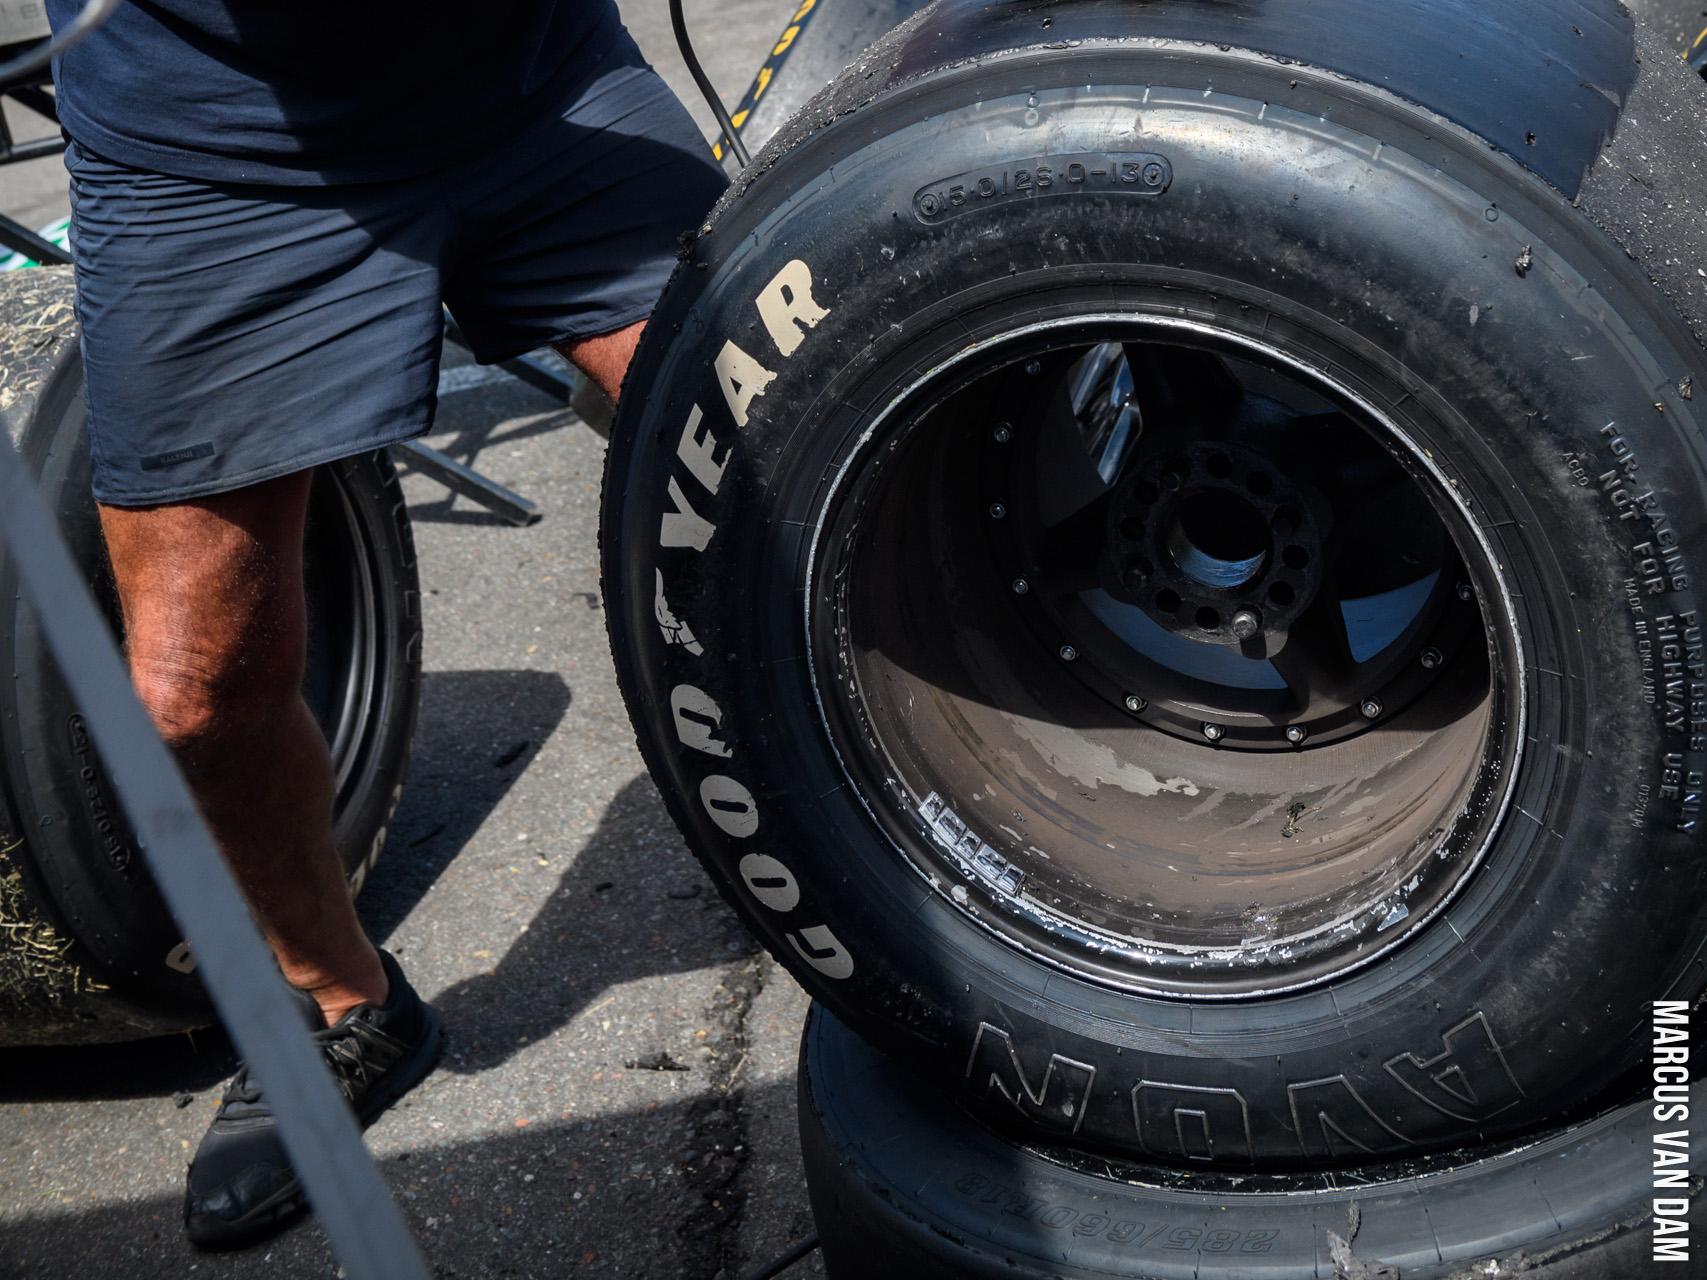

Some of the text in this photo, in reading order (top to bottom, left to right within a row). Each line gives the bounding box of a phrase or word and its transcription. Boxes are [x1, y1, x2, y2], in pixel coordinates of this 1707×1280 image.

[655, 259, 854, 980] GOODYEAR
[1600, 421, 1707, 834] FOR RACING PURPOSES ONLY
[1600, 469, 1685, 801] NOT FOR HIGHWAY USE
[1623, 577, 1656, 705] MADE IN ENGLAND
[964, 1010, 1527, 1167] AVON
[954, 1170, 1280, 1254] 285/660R18
